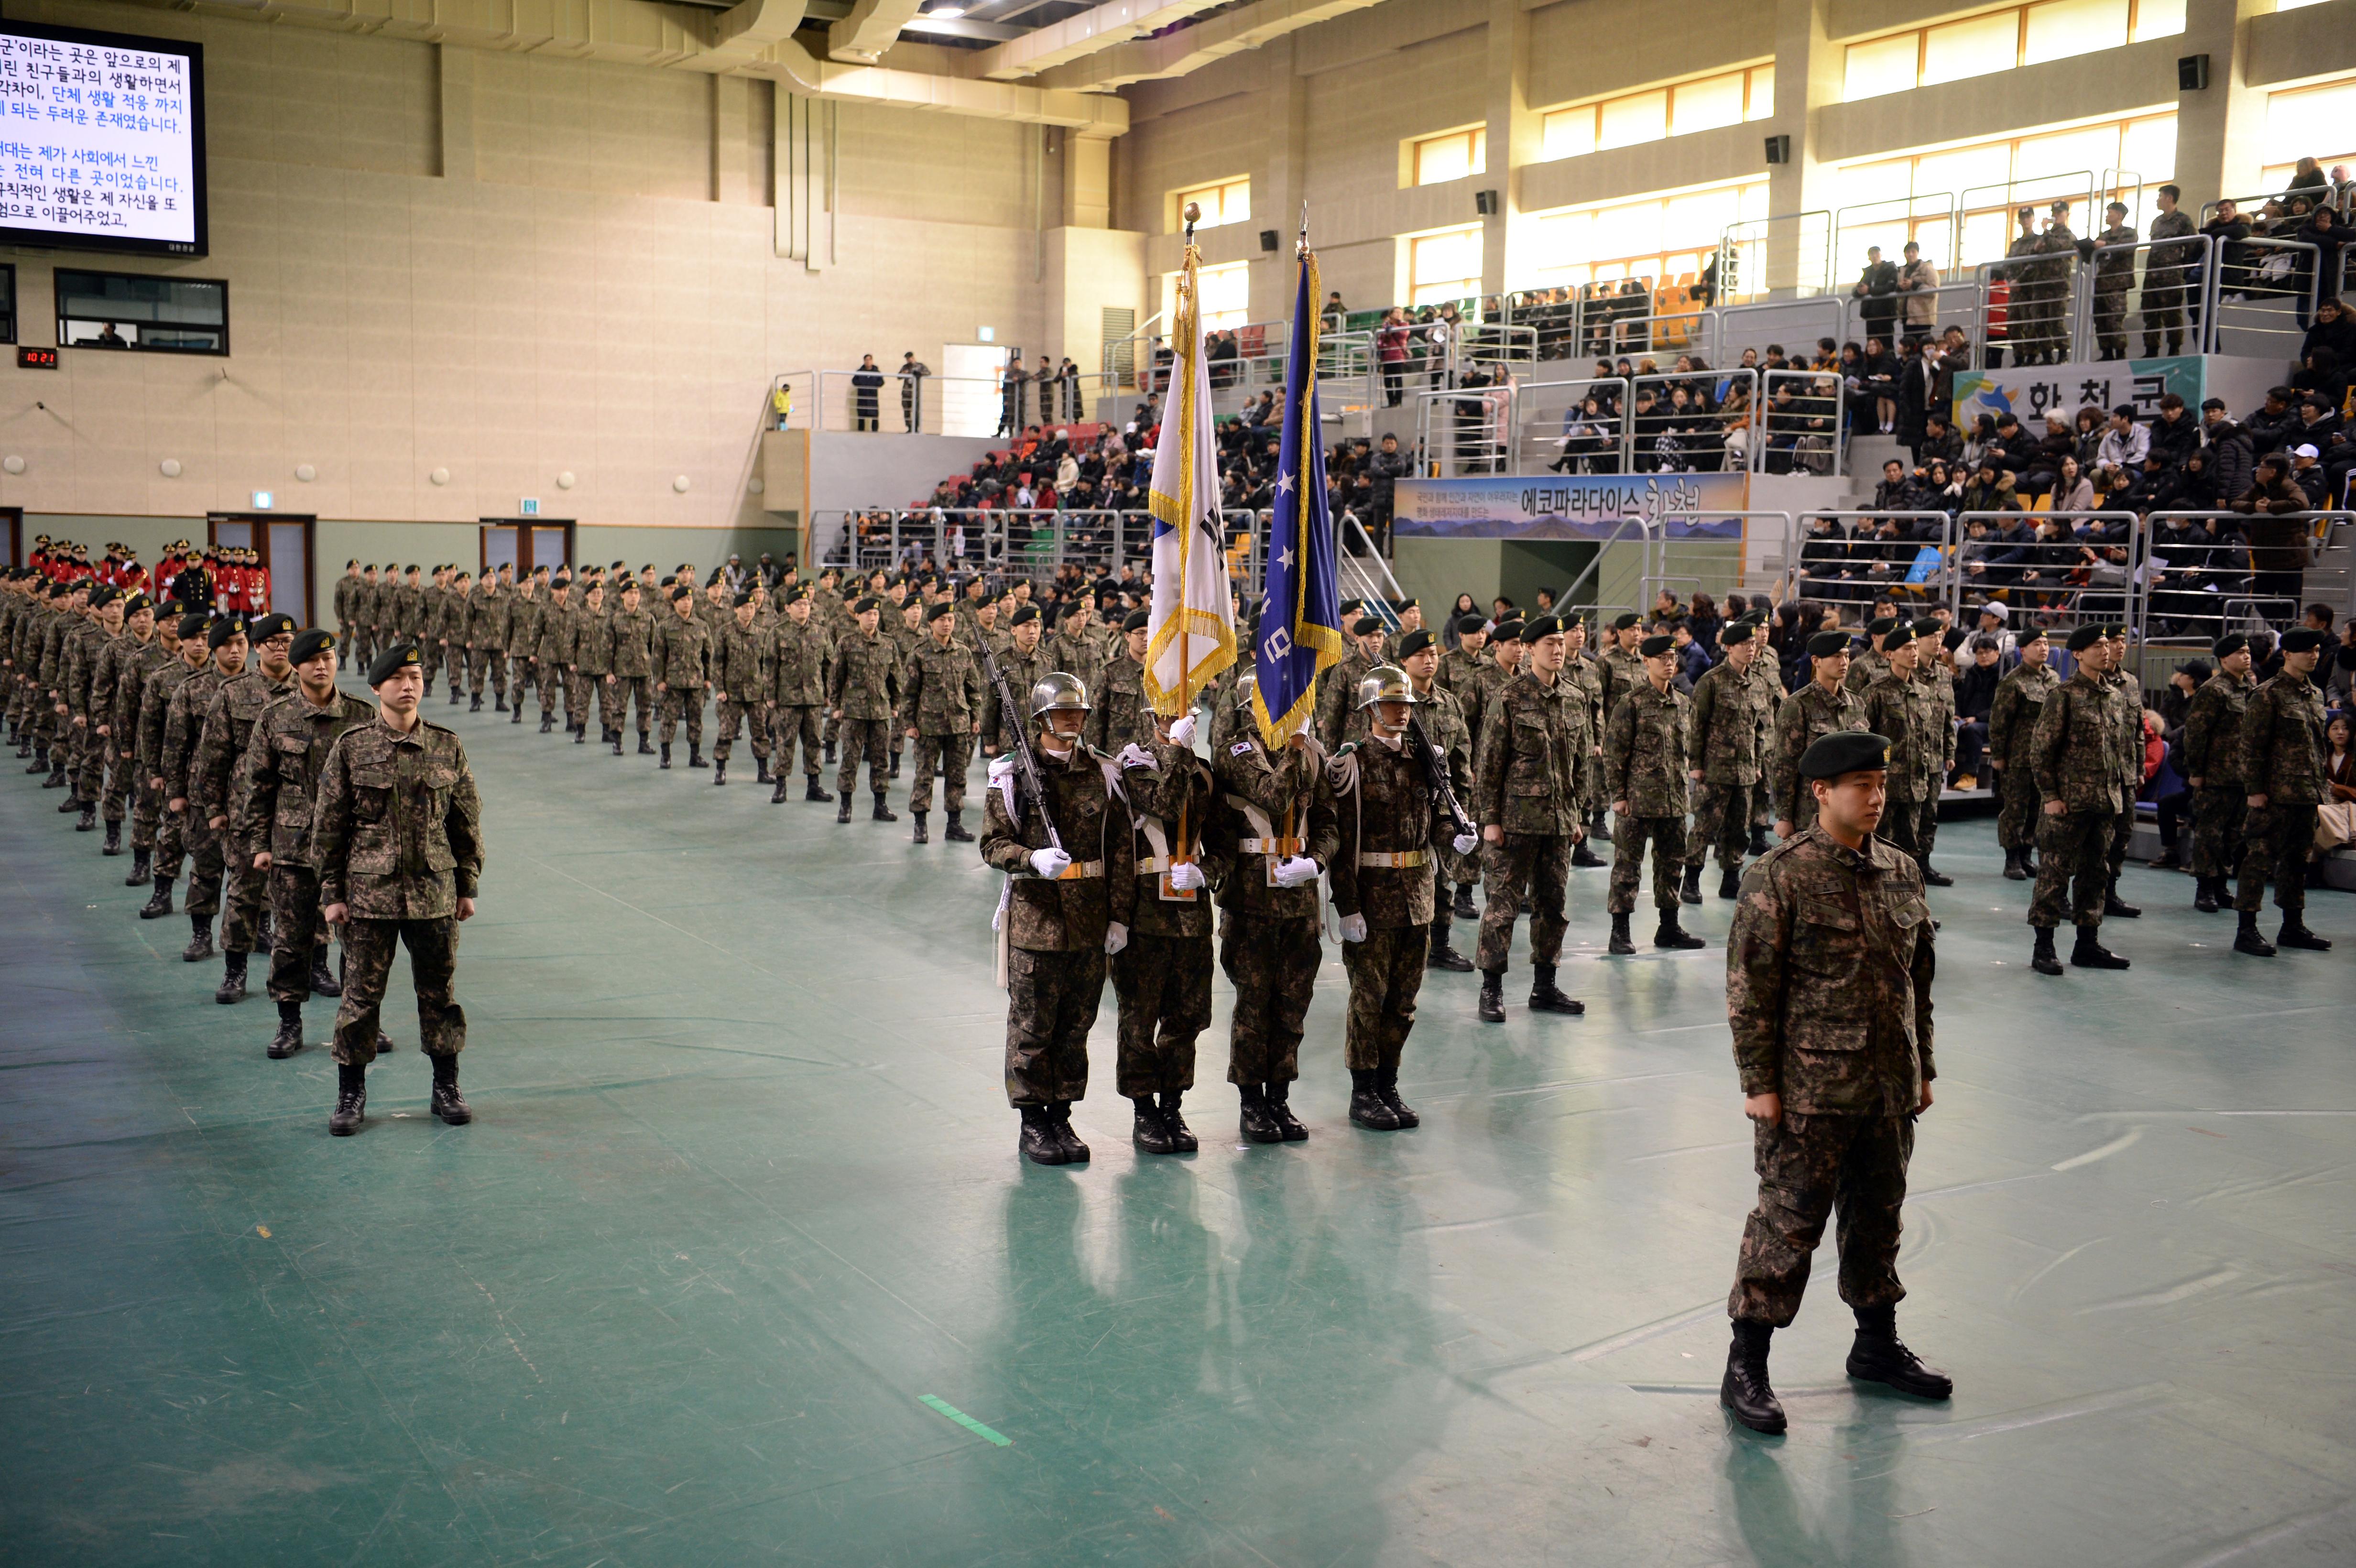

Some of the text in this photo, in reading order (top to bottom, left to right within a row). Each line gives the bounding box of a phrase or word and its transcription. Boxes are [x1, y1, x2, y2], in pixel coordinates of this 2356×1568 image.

[69, 47, 98, 65] 곳은
[104, 52, 161, 72] 앞으로의
[167, 59, 180, 74] 제
[0, 58, 180, 94] 린 친구들과의 생활하면서
[52, 86, 80, 104] 단체
[87, 89, 116, 108] 생활
[122, 94, 149, 111] 적응
[155, 98, 182, 114] 까지
[11, 102, 40, 120] 되는
[46, 106, 88, 125] 두려운
[95, 111, 181, 134] 존재였습니다.
[38, 146, 66, 163] 제가
[72, 149, 126, 168] 사회에서
[131, 154, 158, 172] 느낀
[15, 163, 43, 180] 전혀
[52, 166, 82, 185] 다른
[90, 170, 183, 193] 곳이었습니다.
[53, 186, 94, 205] 생활은
[100, 192, 113, 207] 제
[119, 193, 159, 211] 자신을
[164, 197, 177, 210] 또
[43, 206, 127, 227] 이끌어주었고,
[1521, 478, 1701, 529] 에코파라다이스 화천
